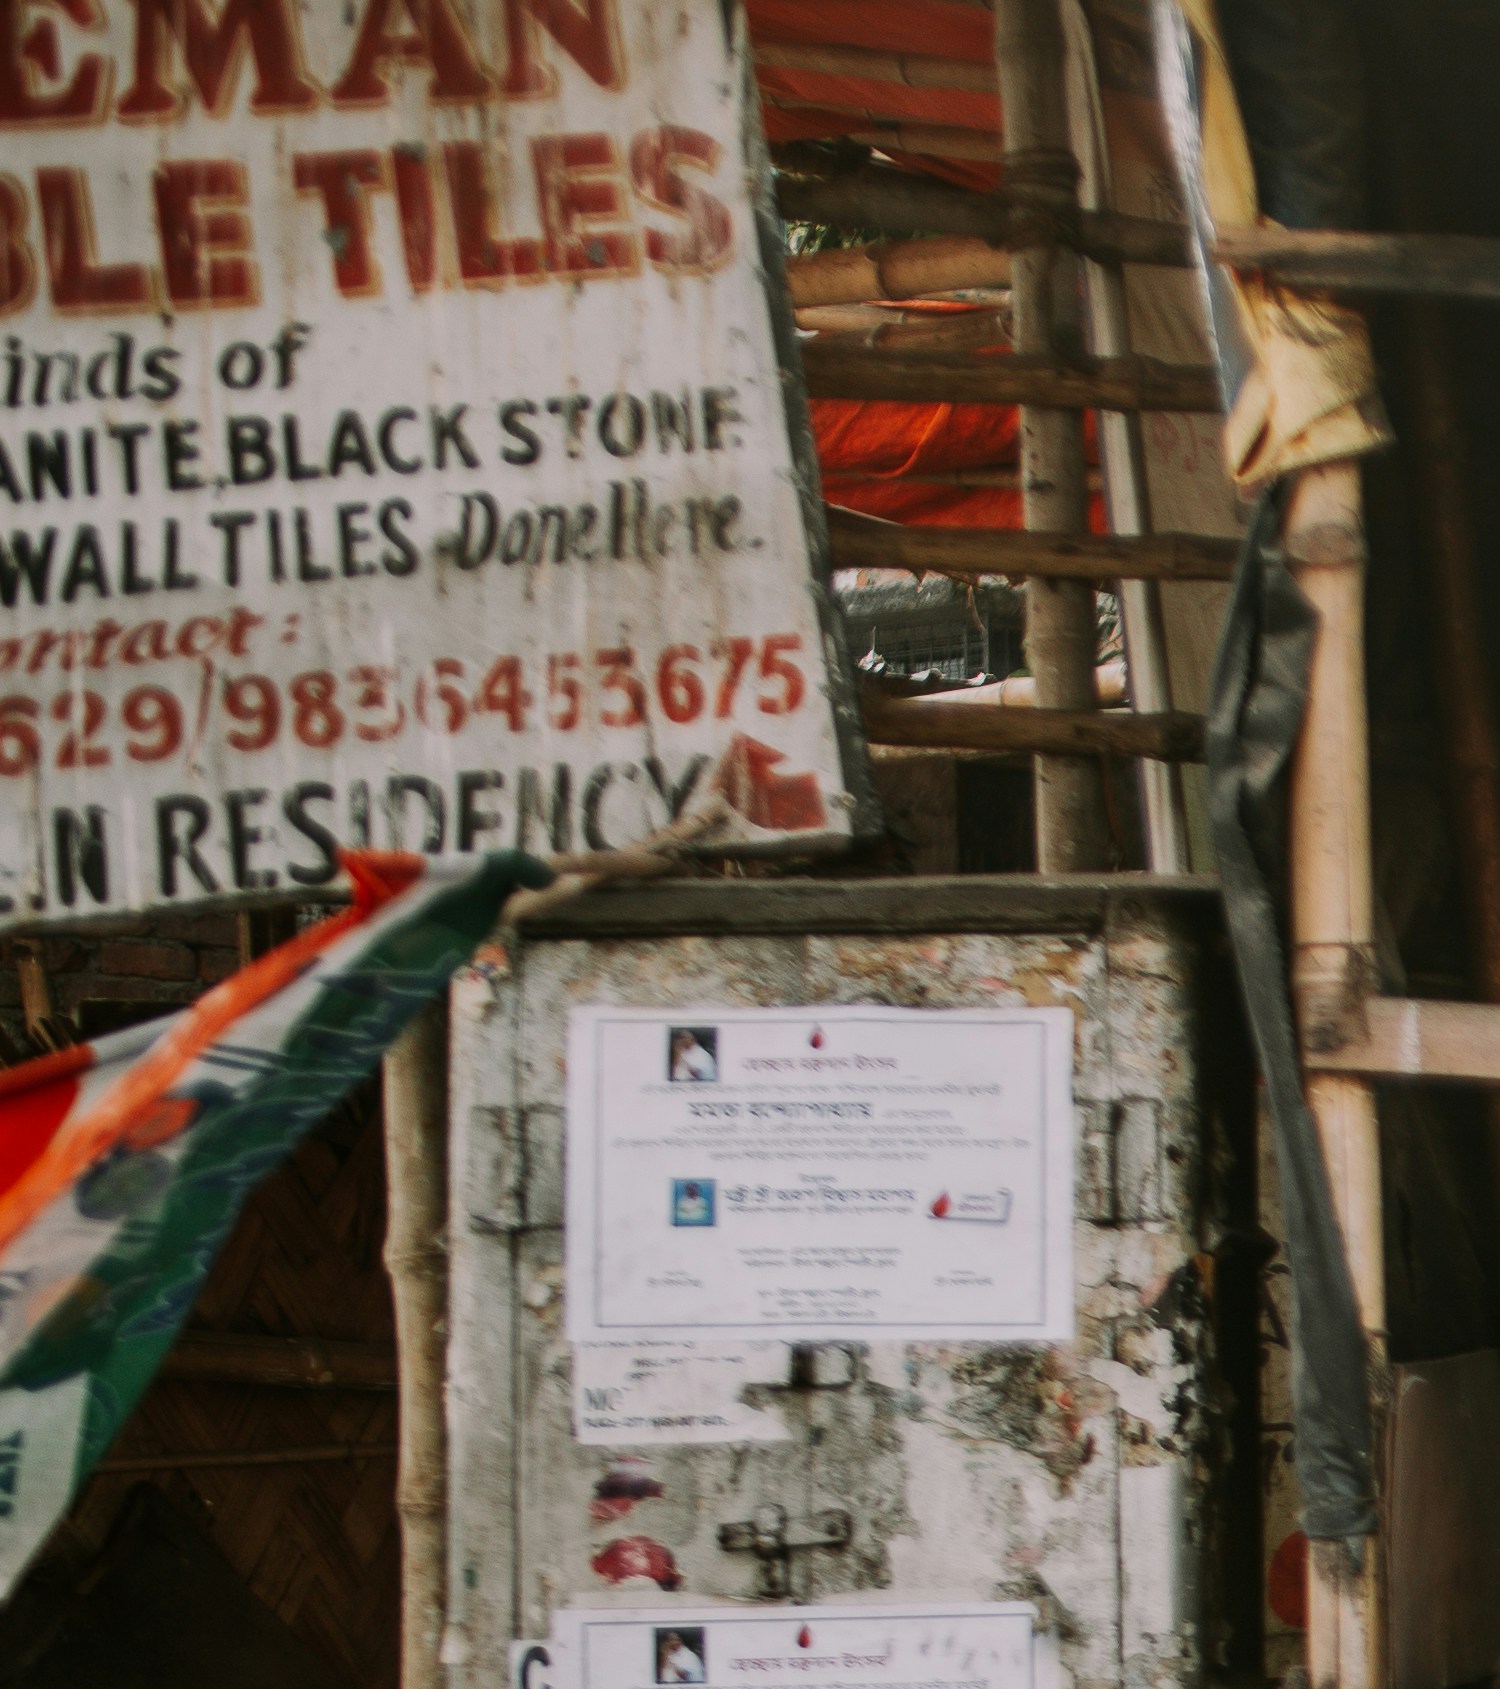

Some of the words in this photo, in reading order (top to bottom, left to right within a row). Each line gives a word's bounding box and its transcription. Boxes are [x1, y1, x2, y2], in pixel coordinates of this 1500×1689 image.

[291, 124, 738, 300] TILES
[217, 321, 312, 391] of
[500, 383, 745, 467] STONE
